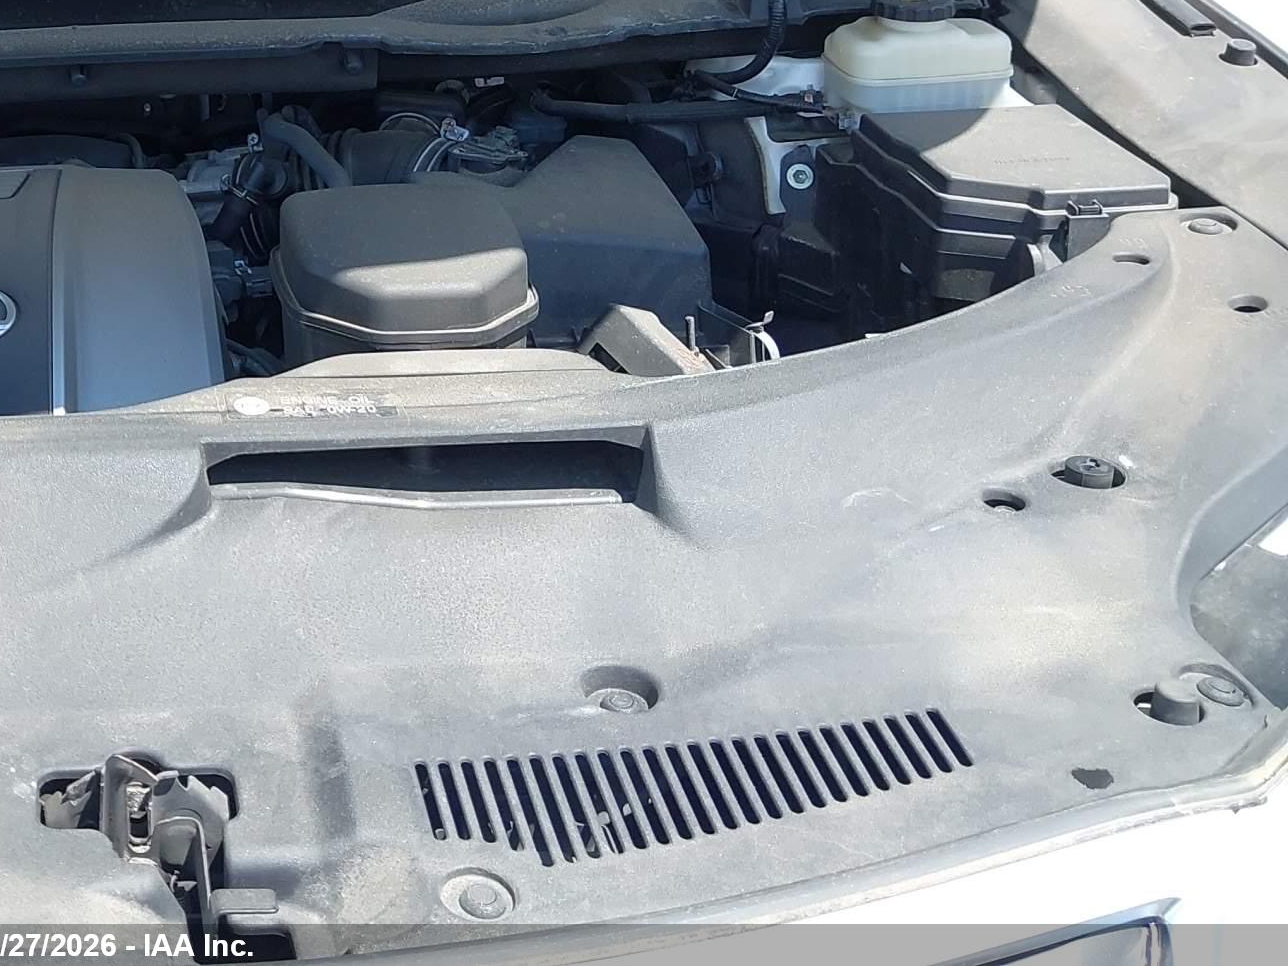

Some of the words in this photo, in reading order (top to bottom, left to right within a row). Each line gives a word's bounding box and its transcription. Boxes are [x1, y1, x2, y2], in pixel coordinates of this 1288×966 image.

[280, 395, 337, 405] ENGINE
[348, 394, 375, 405] OIL
[327, 404, 377, 414] 0W-20
